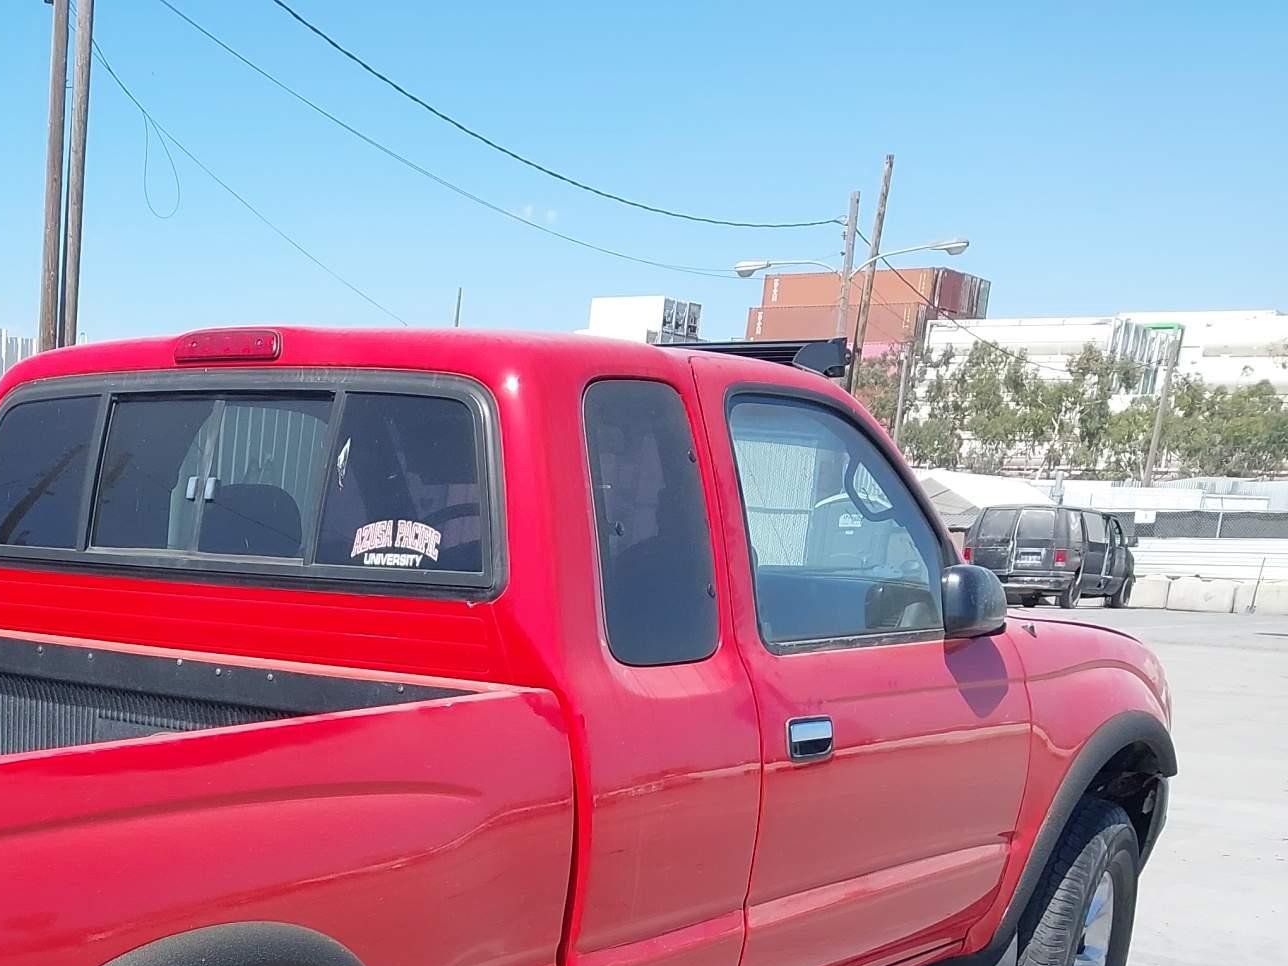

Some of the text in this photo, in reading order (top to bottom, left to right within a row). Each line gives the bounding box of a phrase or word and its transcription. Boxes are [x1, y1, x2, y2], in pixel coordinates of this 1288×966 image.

[351, 519, 441, 563] AZUSA PACIFIC
[363, 552, 424, 567] UNIVERSITY
